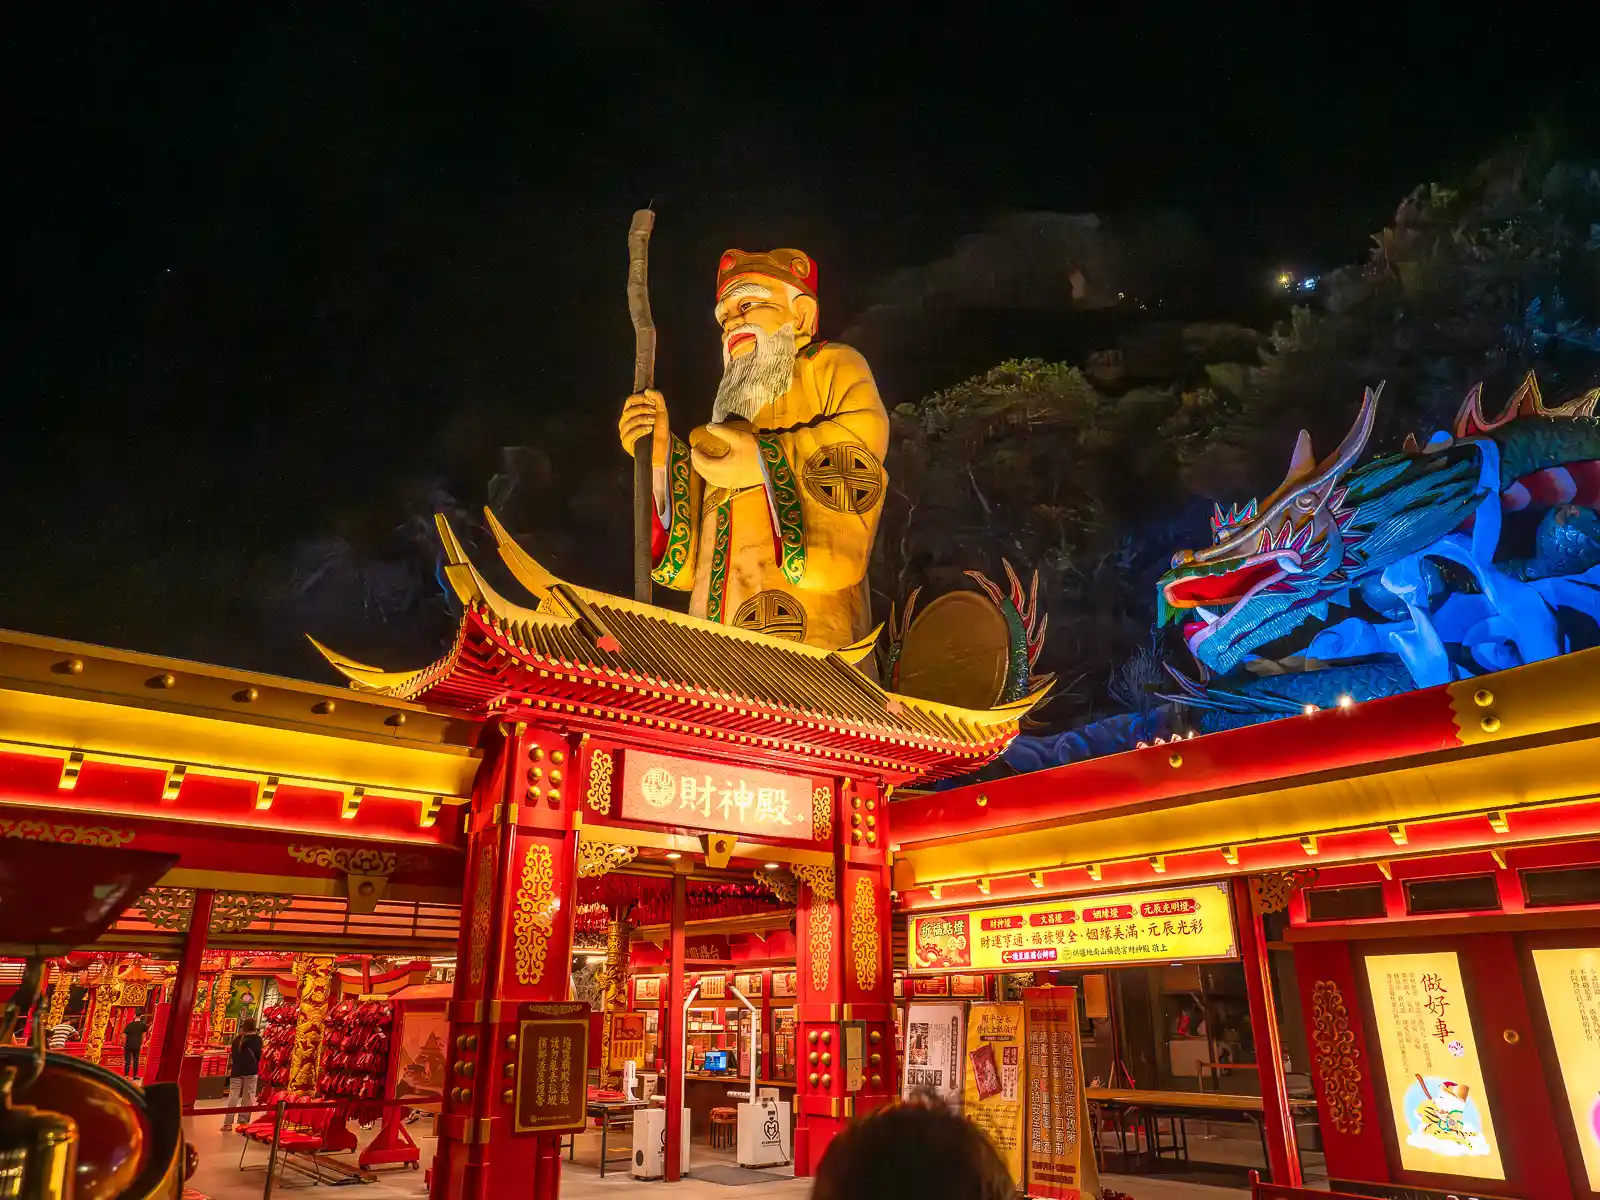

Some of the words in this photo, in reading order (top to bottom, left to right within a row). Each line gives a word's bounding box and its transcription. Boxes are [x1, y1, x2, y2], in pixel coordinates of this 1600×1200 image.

[678, 775, 792, 825] 財神殿
[1092, 908, 1119, 919] 姻緣燈
[1143, 901, 1190, 915] 元辰光明燈
[989, 918, 1012, 928] 財神燈
[1040, 913, 1063, 925] 文昌燈
[921, 920, 965, 938] 祈福點燈
[1420, 973, 1455, 1044] 做好事
